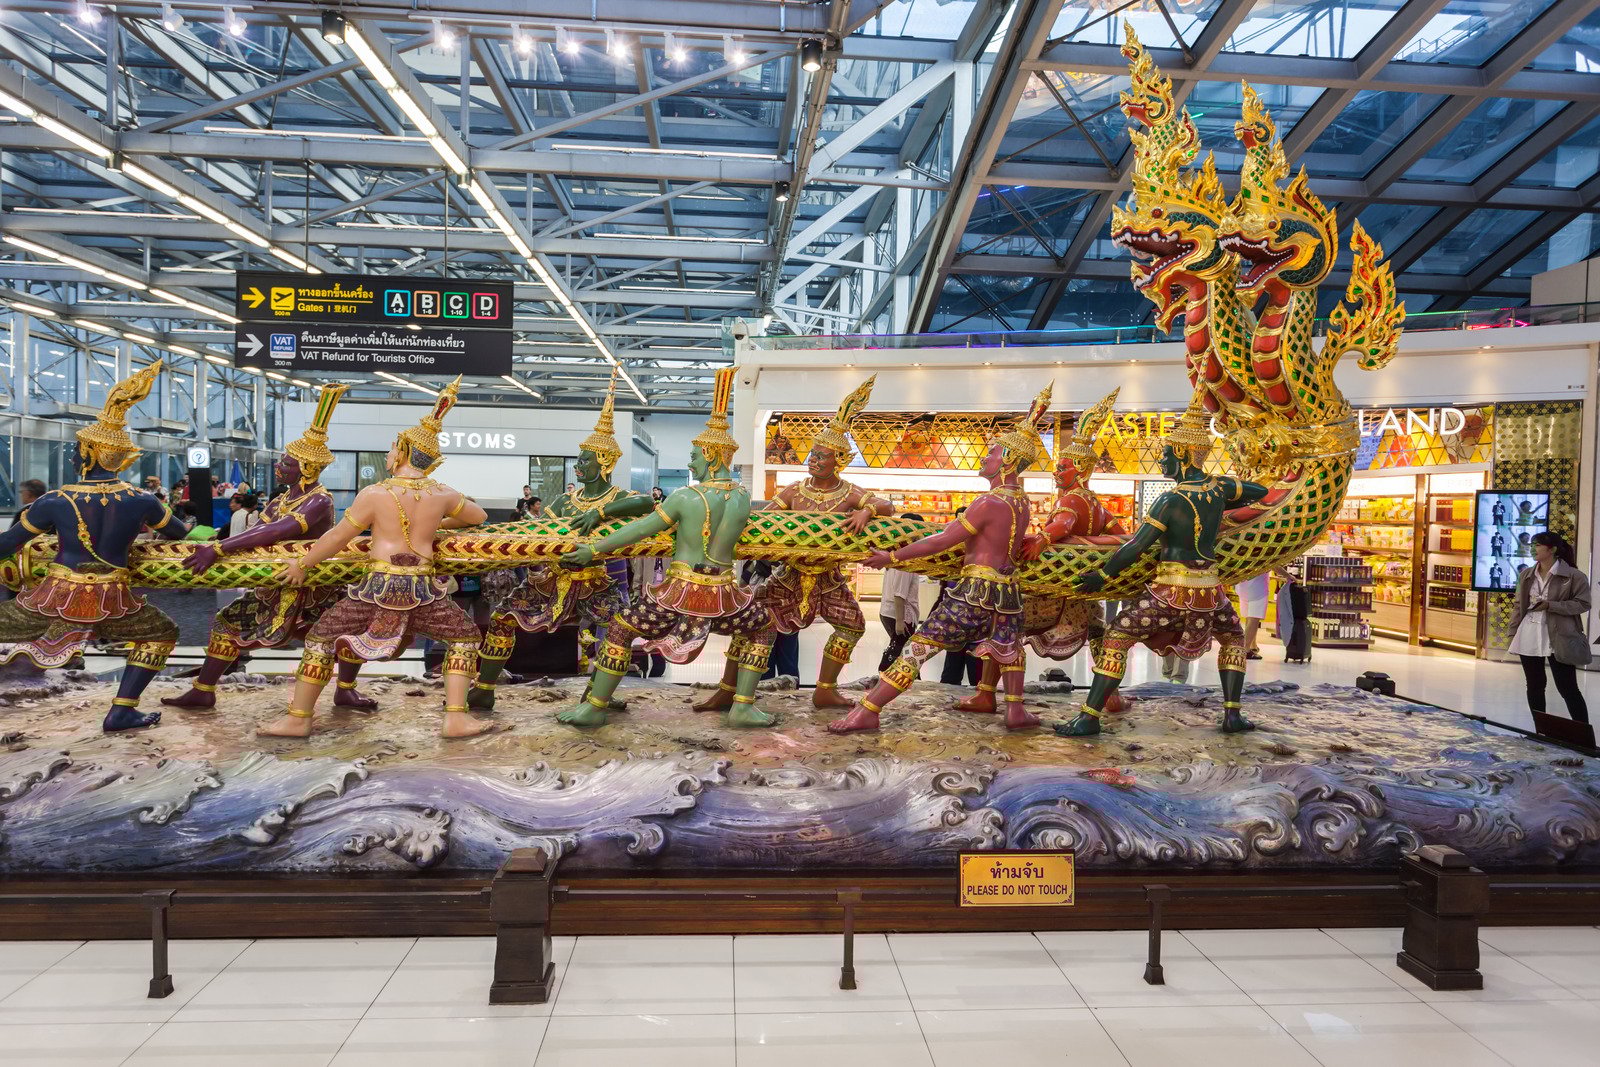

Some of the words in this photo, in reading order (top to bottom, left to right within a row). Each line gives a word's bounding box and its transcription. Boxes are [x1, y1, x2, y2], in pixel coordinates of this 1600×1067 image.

[297, 303, 324, 312] Gates
[390, 292, 405, 308] A
[421, 294, 434, 309] B
[449, 295, 463, 310] C
[480, 296, 494, 311] D
[274, 336, 293, 345] VAT
[300, 350, 319, 360] VAT
[321, 351, 354, 361] Refund
[356, 352, 369, 362] for
[372, 353, 406, 363] Tourists
[408, 354, 435, 364] Office
[438, 432, 516, 449] STOMS
[990, 861, 1044, 879] ห้ามจับ
[967, 885, 998, 895] PLEASE
[1002, 885, 1014, 895] DO
[1018, 885, 1035, 895] NOT
[1038, 884, 1067, 895] TOUCH
